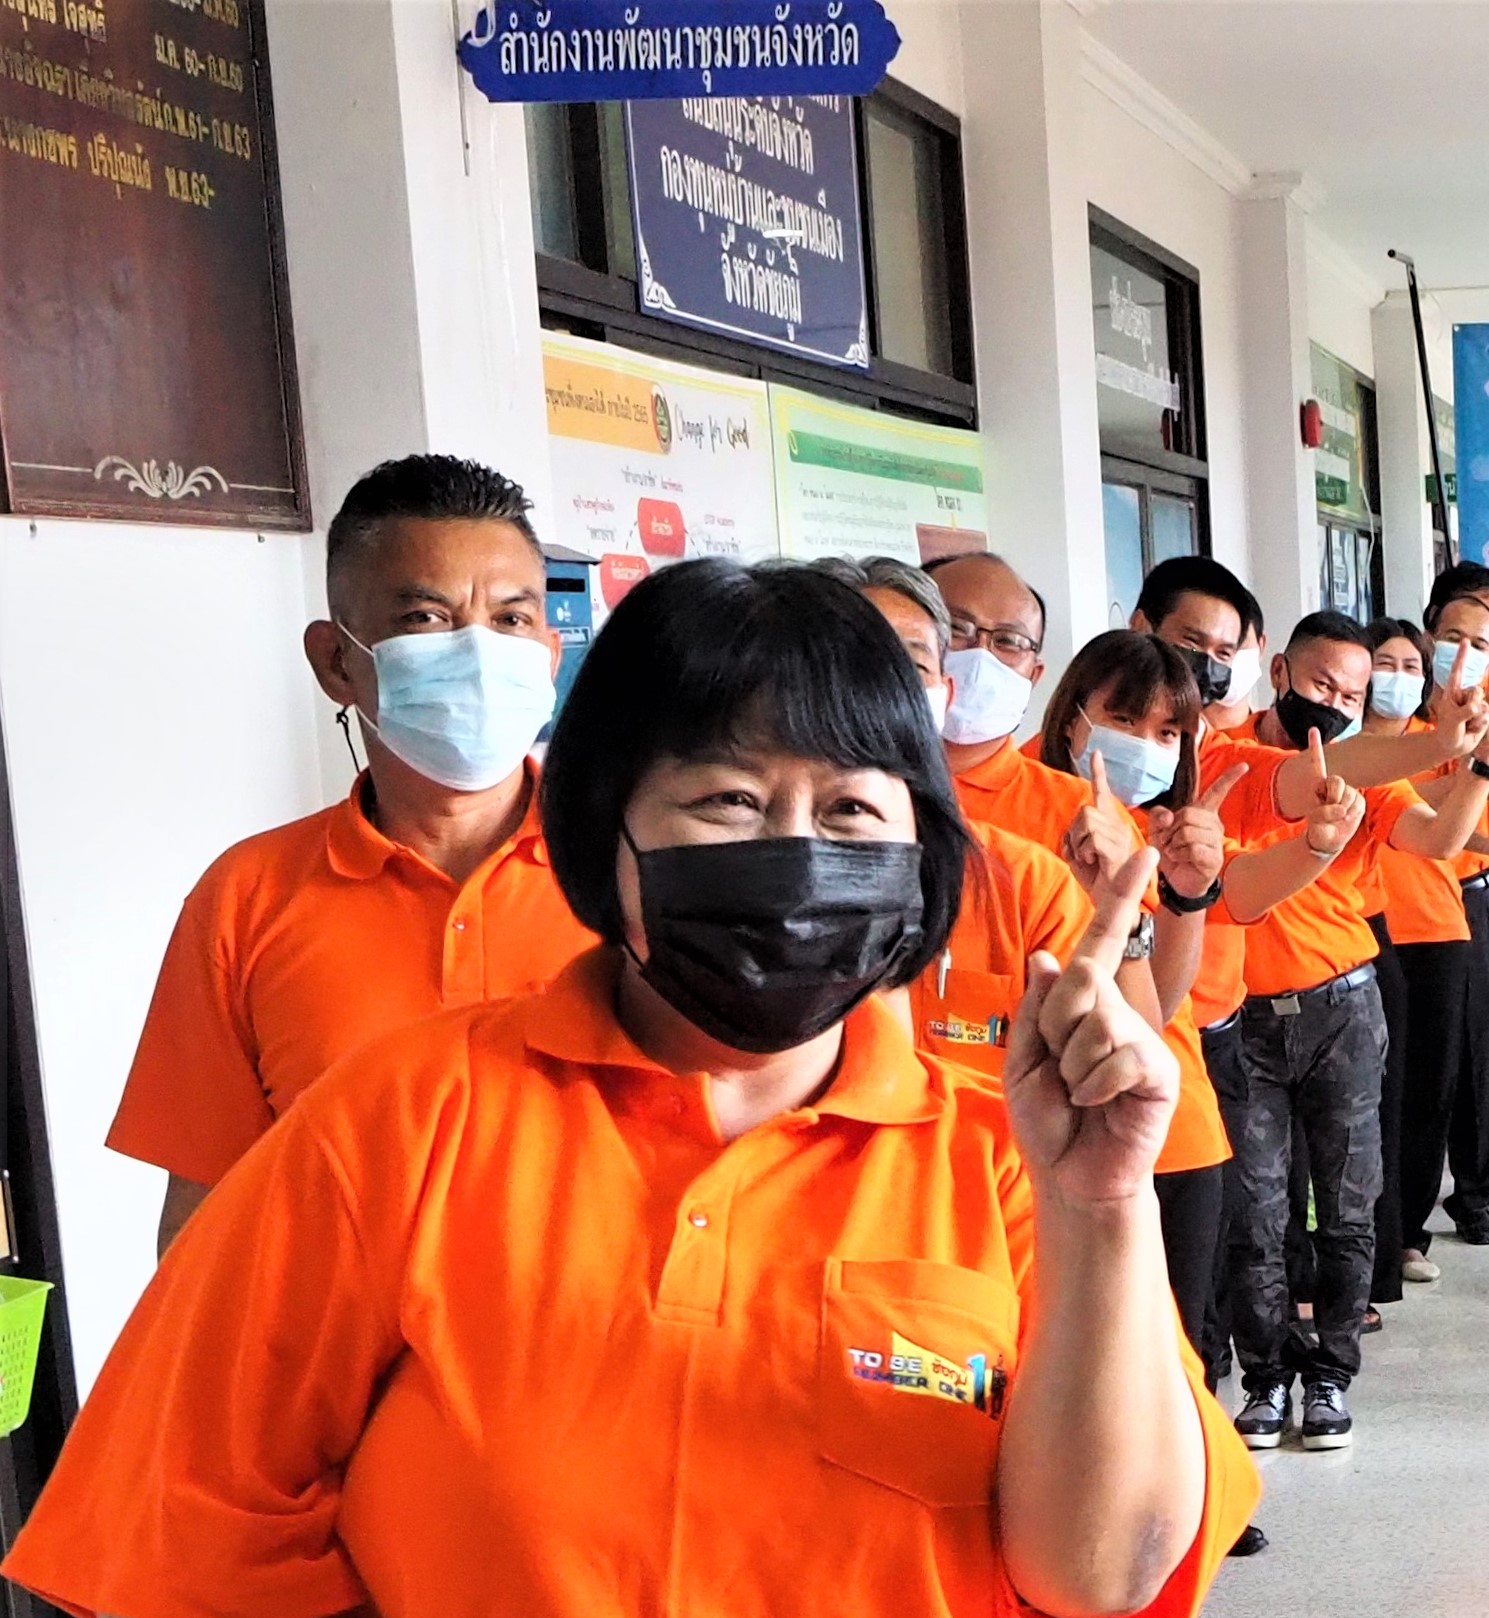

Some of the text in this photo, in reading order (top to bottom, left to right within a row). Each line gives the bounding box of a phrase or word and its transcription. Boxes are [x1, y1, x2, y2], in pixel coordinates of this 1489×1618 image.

[500, 2, 859, 94] สำนักงานพัฒนาชุมชนจังหวัด
[847, 1347, 923, 1373] TO BE
